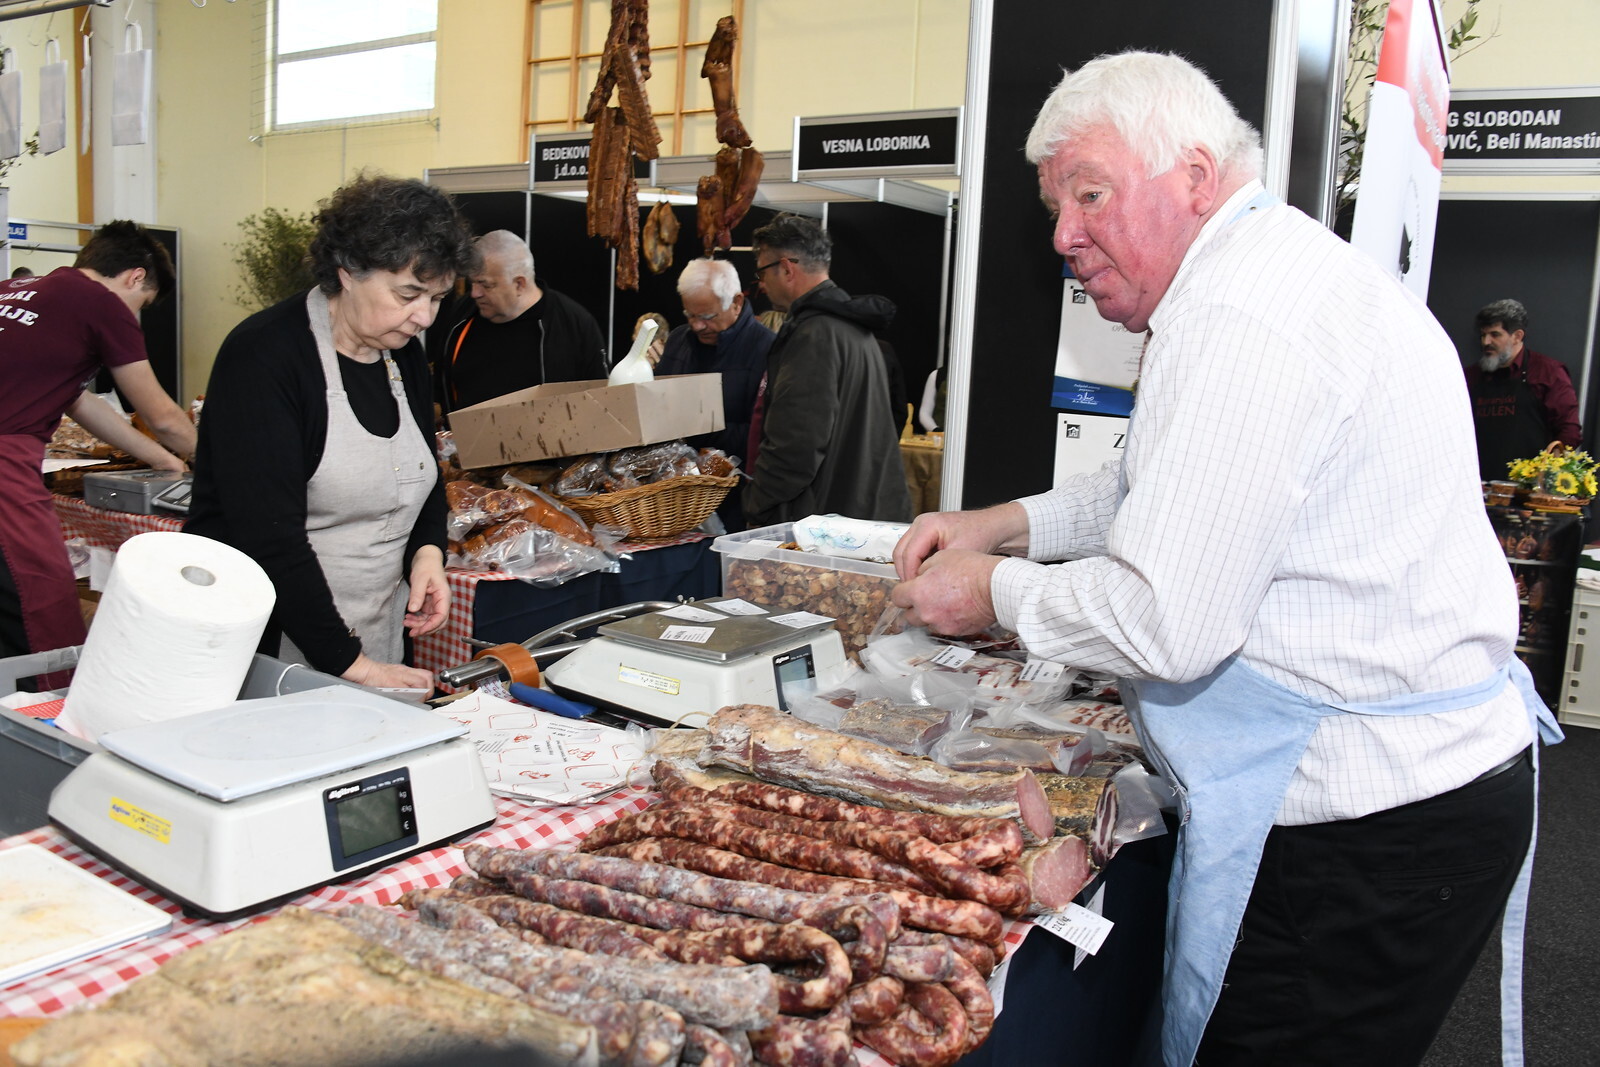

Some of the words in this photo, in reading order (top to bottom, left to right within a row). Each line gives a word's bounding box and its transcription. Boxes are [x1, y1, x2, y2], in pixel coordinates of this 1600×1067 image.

[1463, 110, 1561, 127] SLOBODAN
[822, 139, 864, 153] VESNA
[866, 135, 931, 151] LOBORIKA
[1487, 132, 1521, 149] Beli
[554, 163, 588, 179] j.d.o.o.
